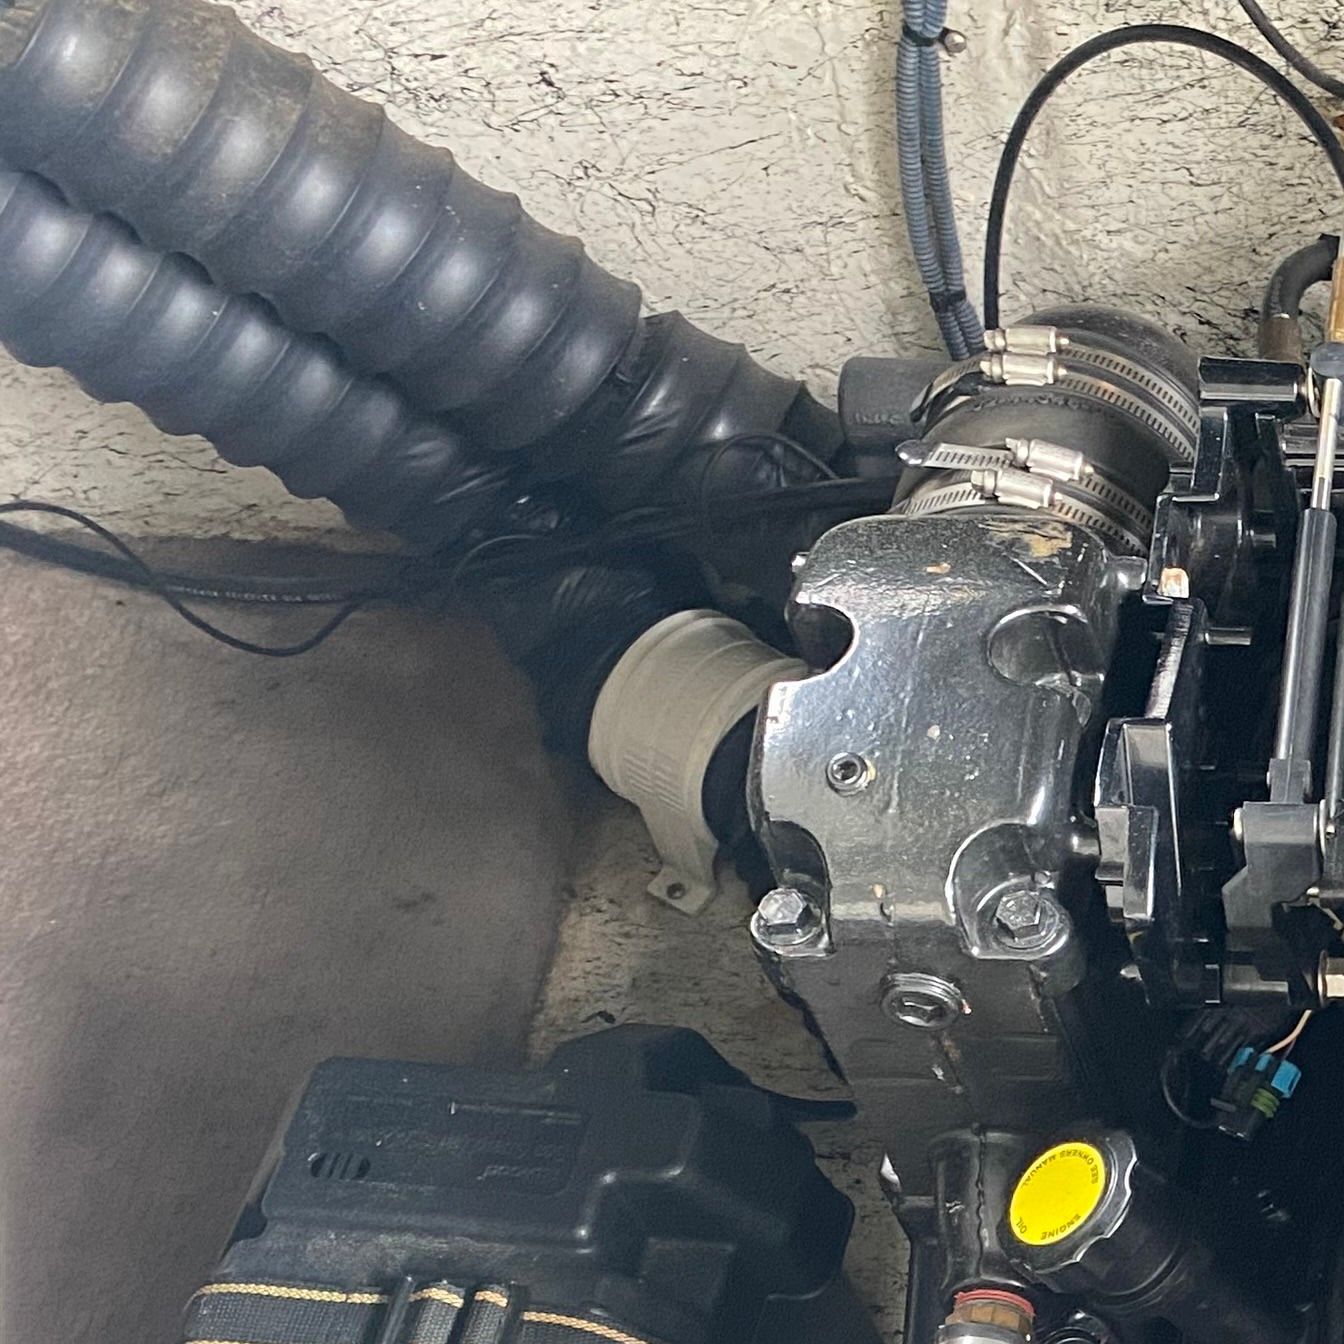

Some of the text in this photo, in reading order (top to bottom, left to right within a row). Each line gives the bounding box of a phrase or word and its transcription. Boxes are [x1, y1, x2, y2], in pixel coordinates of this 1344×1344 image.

[1023, 1154, 1057, 1186] MANUAL
[1090, 1165, 1099, 1184] SEE
[1016, 1217, 1027, 1234] OIL
[1040, 1214, 1081, 1240] ENGINE
